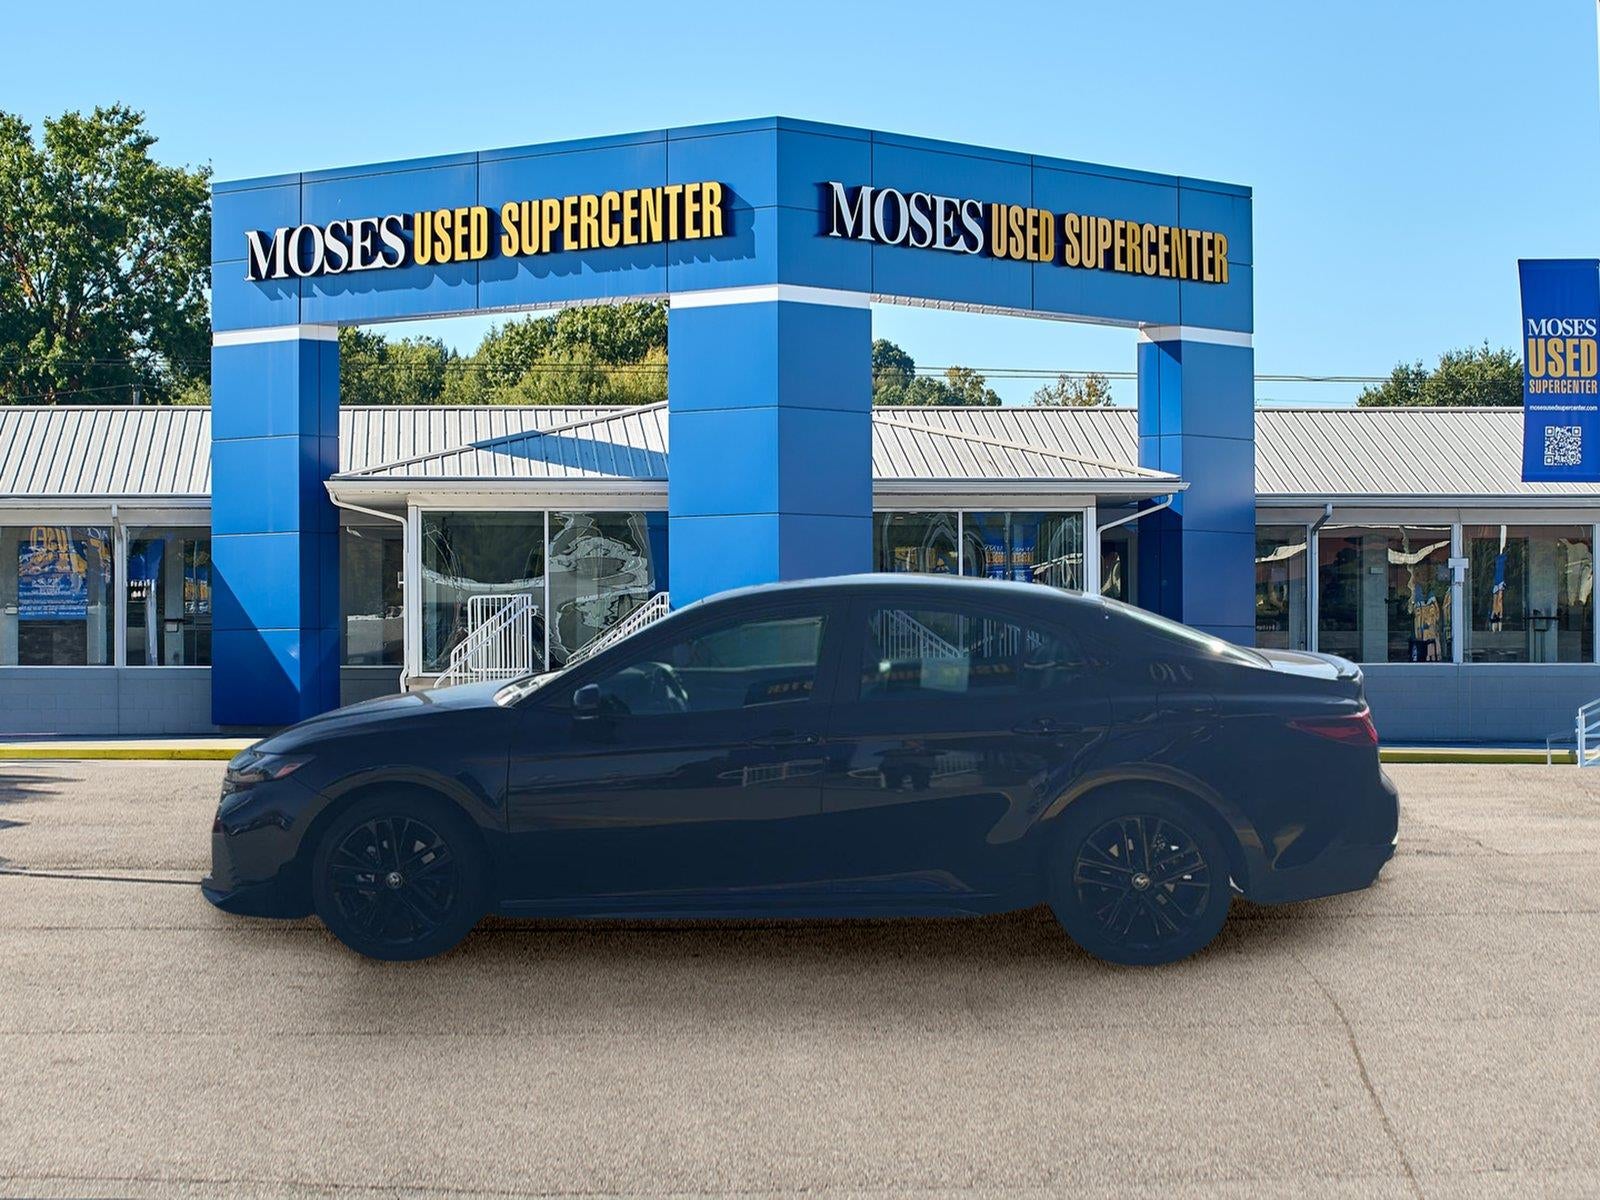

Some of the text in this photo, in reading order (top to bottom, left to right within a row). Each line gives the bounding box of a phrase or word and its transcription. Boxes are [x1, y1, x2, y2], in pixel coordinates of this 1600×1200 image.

[244, 181, 724, 282] MOSES USED SUPERCENTER
[828, 181, 1230, 284] MOSES USED SUPERCENTER
[1528, 318, 1597, 336] MOSES
[1528, 338, 1598, 377] USED
[1529, 379, 1598, 394] SUPERCENTER
[1529, 404, 1598, 412] mosesusedsupercenter.com
